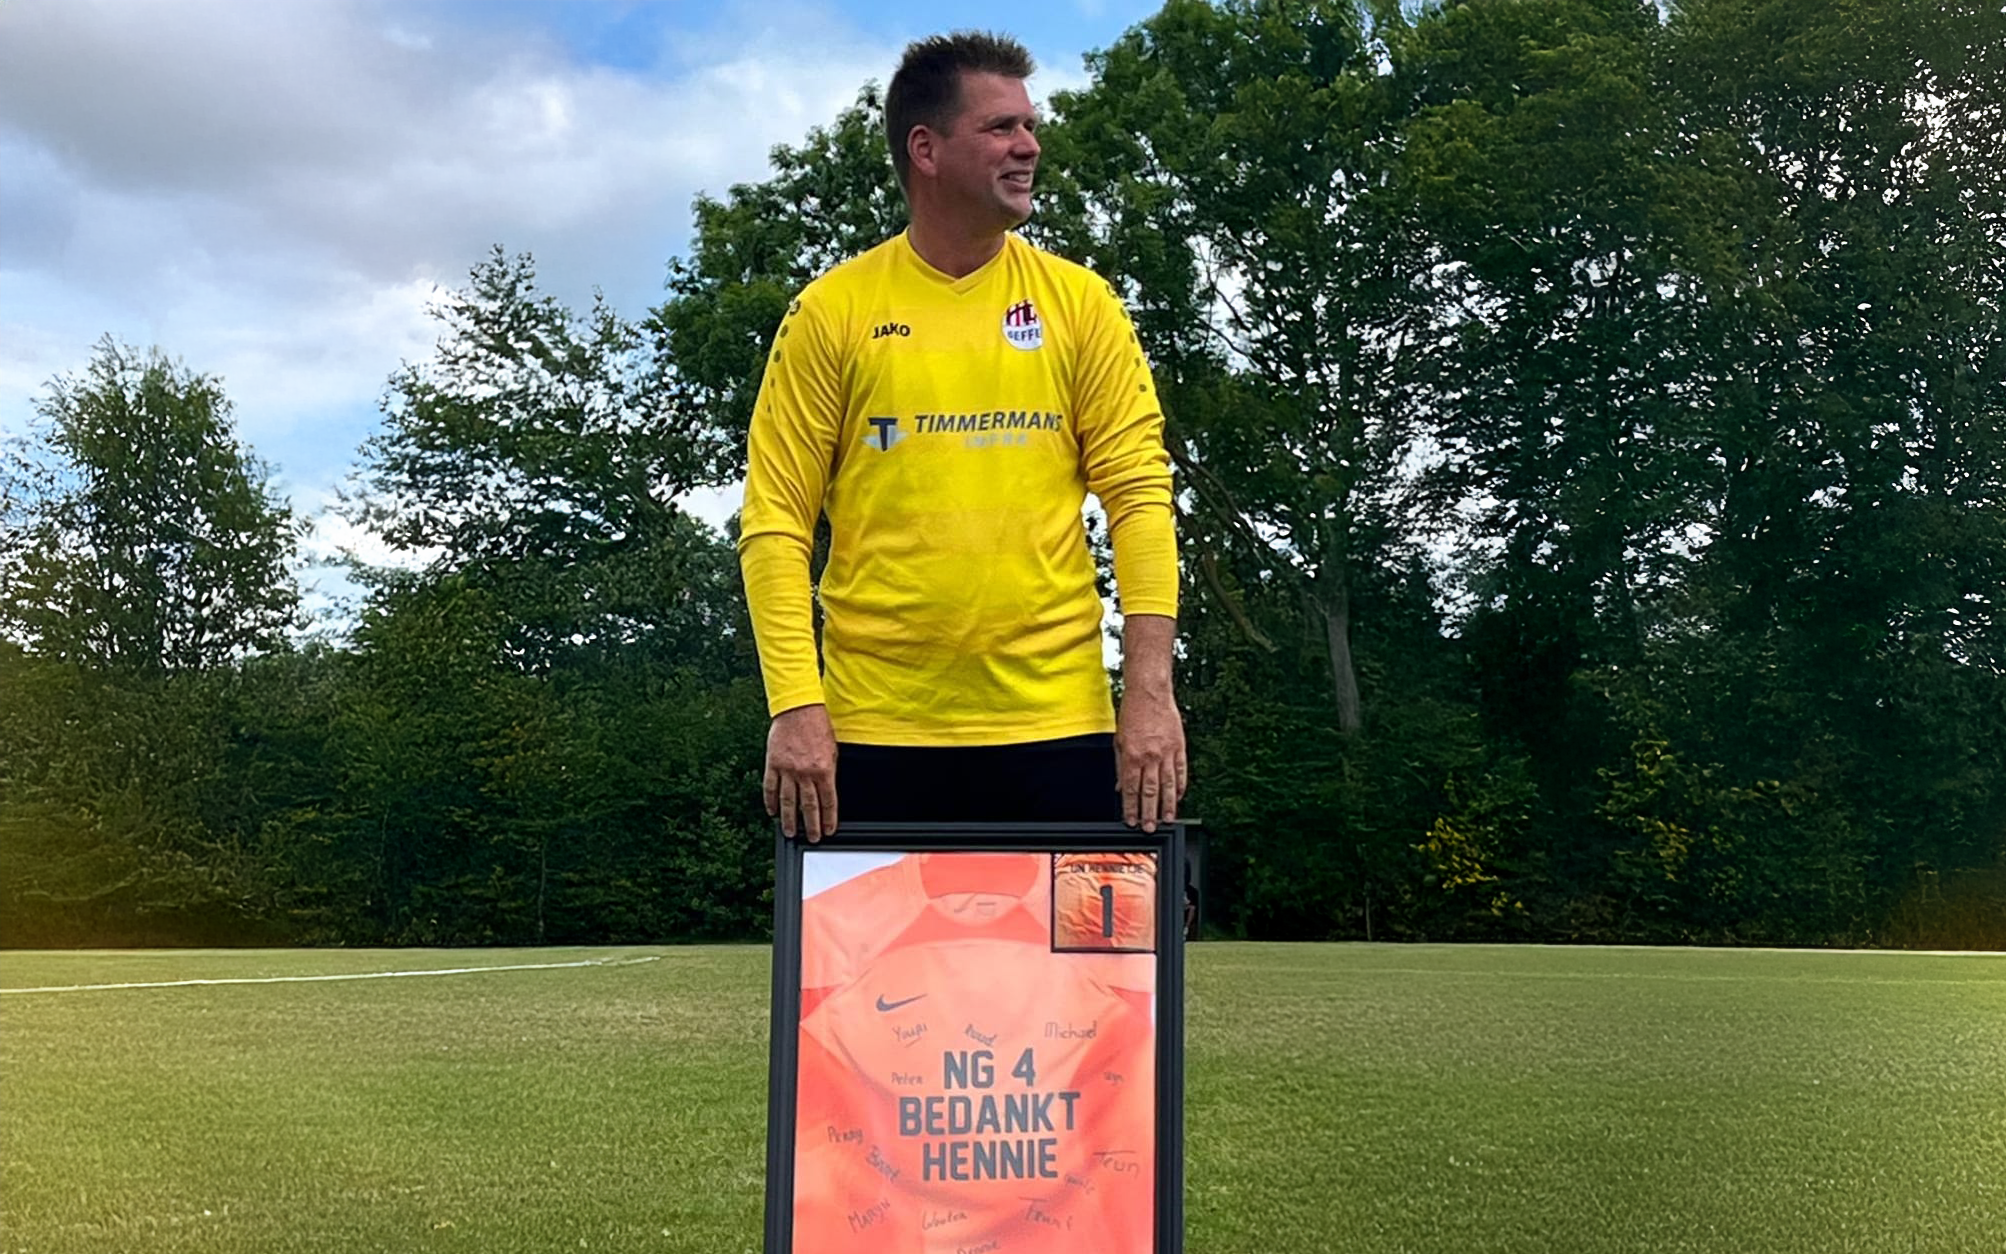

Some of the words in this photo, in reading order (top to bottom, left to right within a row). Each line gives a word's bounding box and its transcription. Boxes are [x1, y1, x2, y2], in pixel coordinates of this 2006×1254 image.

[872, 322, 910, 339] JAKO
[914, 411, 1063, 433] TIMMERMANS
[1100, 884, 1113, 938] 1
[1045, 1021, 1097, 1039] Michael
[943, 1051, 995, 1090] NG
[1011, 1047, 1036, 1087] 4
[899, 1092, 1081, 1136] BEDANKT
[922, 1138, 1058, 1181] HENNIE
